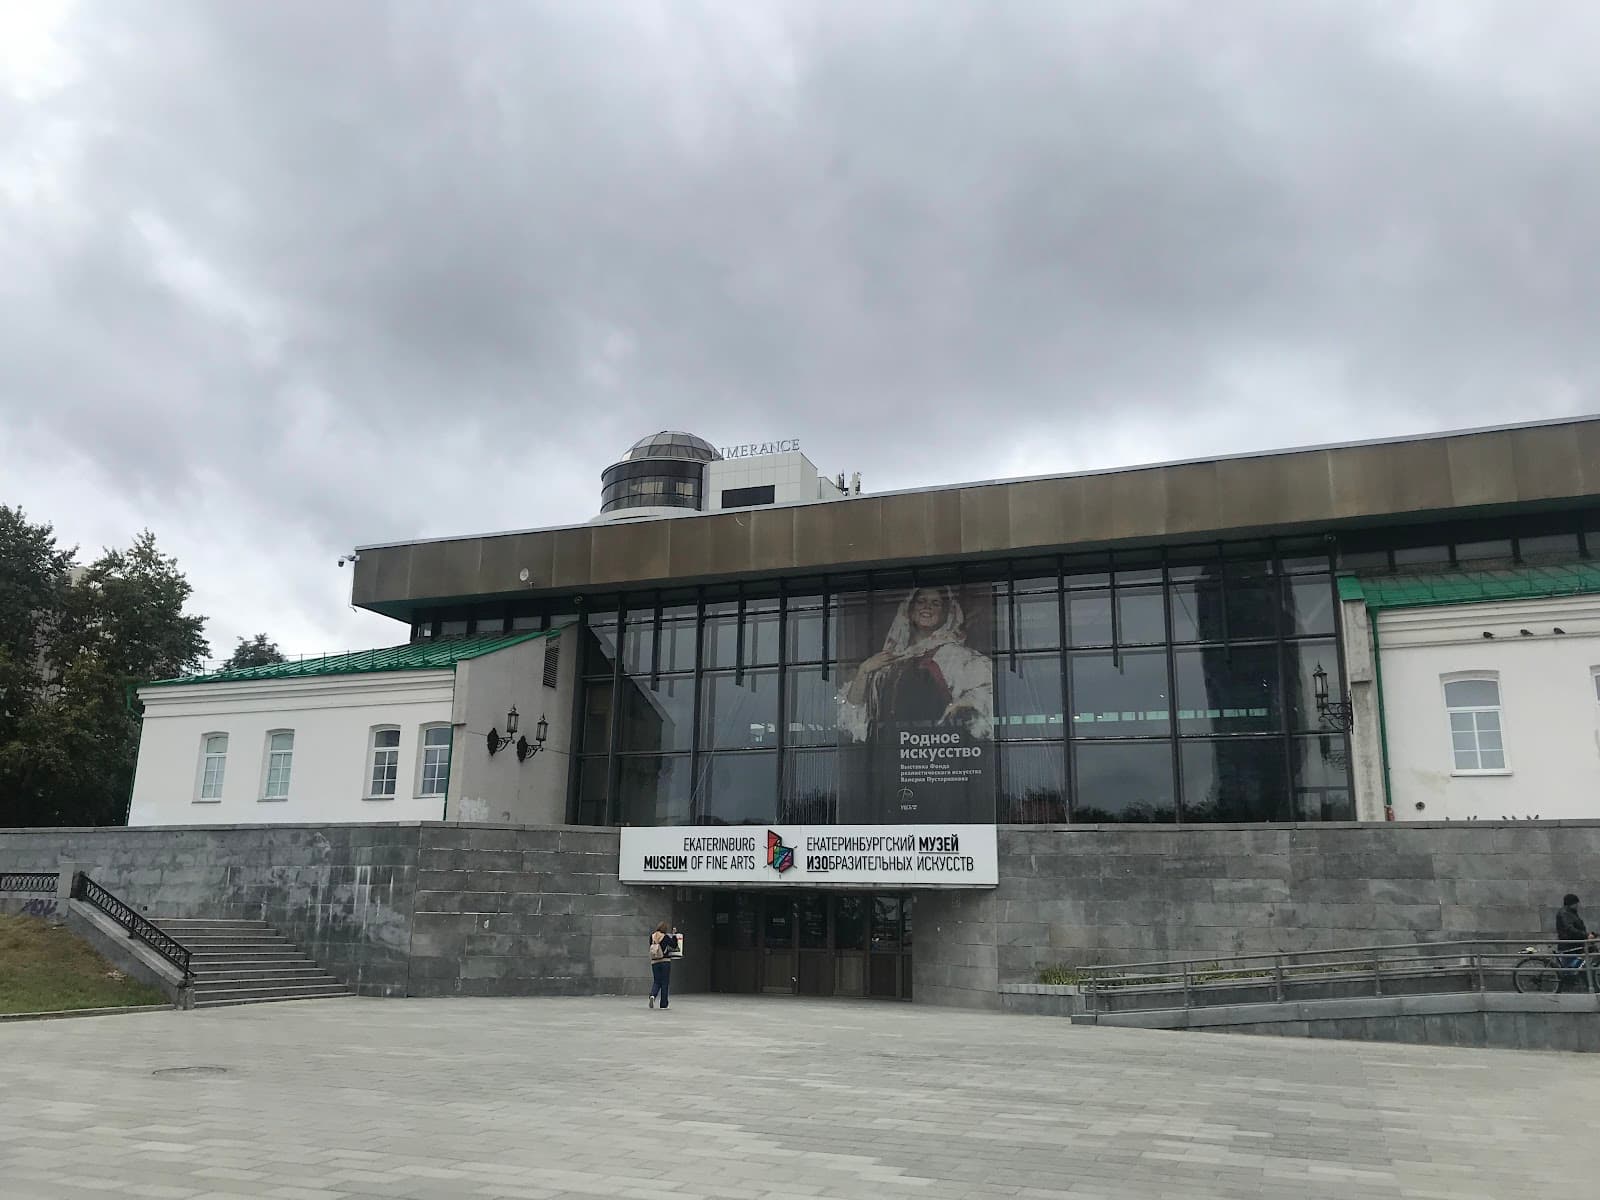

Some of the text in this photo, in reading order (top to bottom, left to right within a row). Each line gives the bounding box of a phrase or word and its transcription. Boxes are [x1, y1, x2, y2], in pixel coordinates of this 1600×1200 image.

[900, 731, 960, 746] Родное
[900, 747, 981, 761] искусство
[683, 837, 755, 851] EKATERINBURG
[806, 833, 959, 853] ЕКАТЕРИНБУРГСКИЙ МУЗЕЙ
[643, 855, 755, 871] MUSEUM OF FINE ARTS
[806, 855, 974, 871] ИЗОБРАЗИТЕЛЬНЫХ ИСКУССТВ
